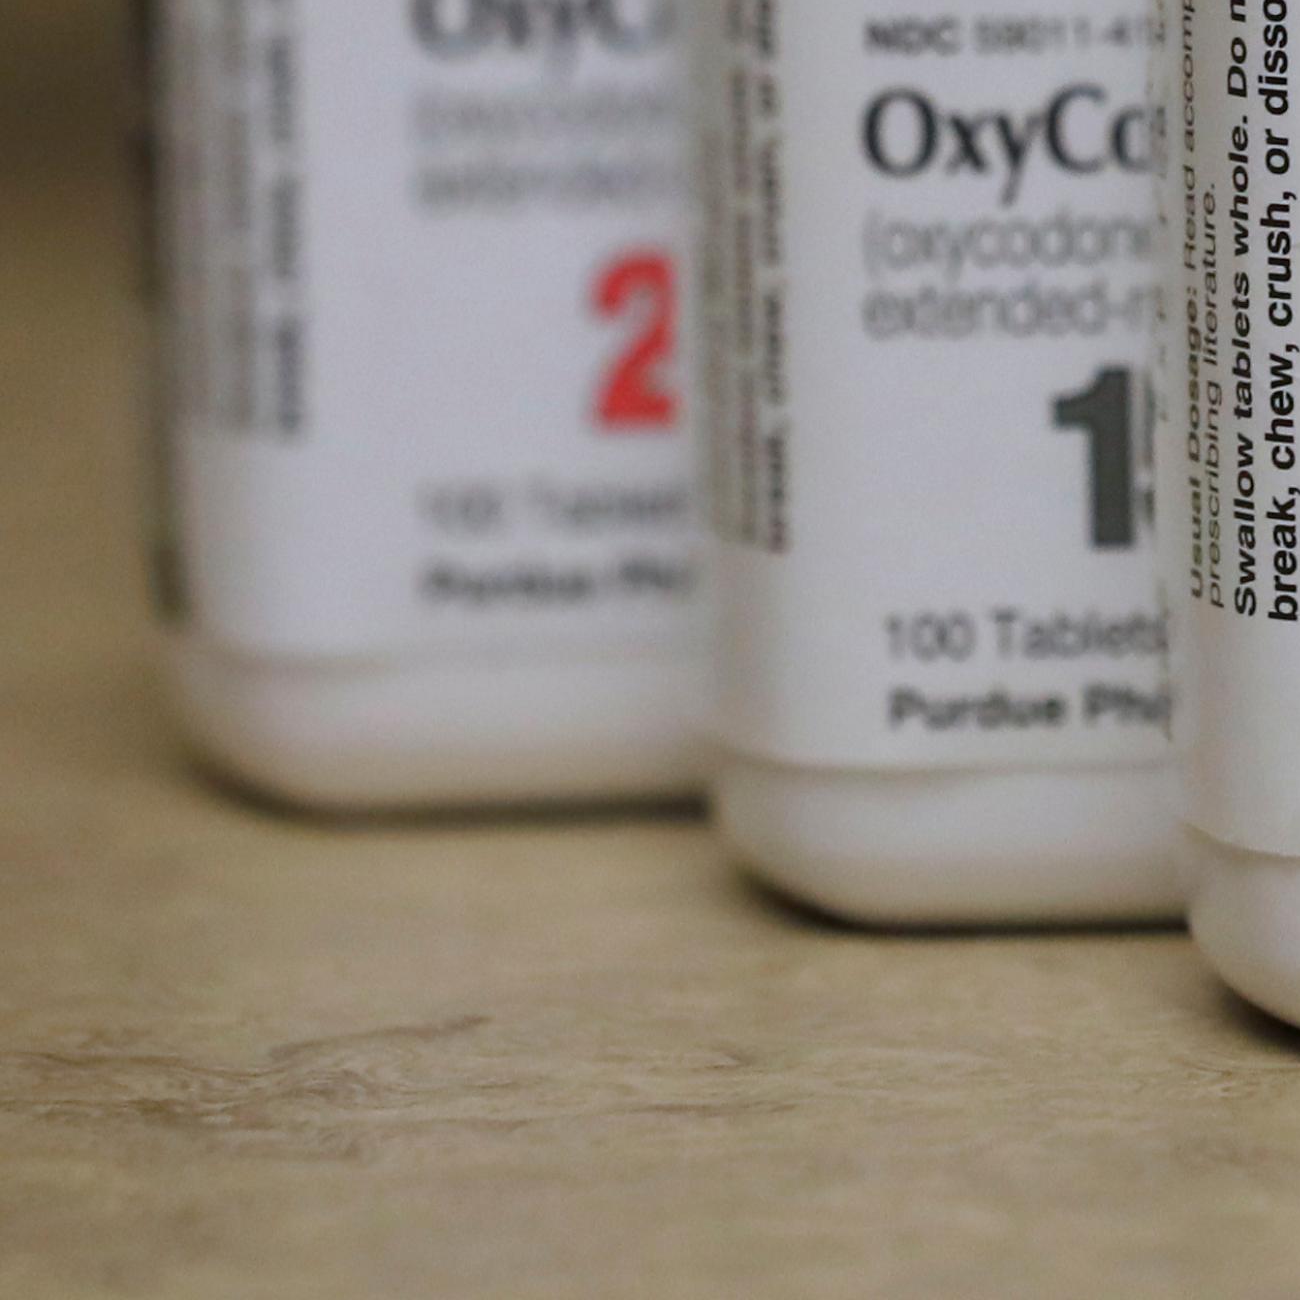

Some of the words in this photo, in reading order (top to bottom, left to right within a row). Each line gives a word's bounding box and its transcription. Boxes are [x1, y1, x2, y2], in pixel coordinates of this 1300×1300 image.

[1227, 36, 1248, 98] Do
[861, 83, 1152, 205] OxyCo
[1229, 114, 1250, 257] whole.
[1264, 128, 1290, 175] or
[1202, 182, 1219, 365] literature.
[1260, 191, 1297, 327] crush,
[1231, 271, 1253, 420] tablets
[1264, 343, 1300, 471] chew,
[1204, 380, 1223, 608] prescribing
[1234, 433, 1256, 616] Swallow
